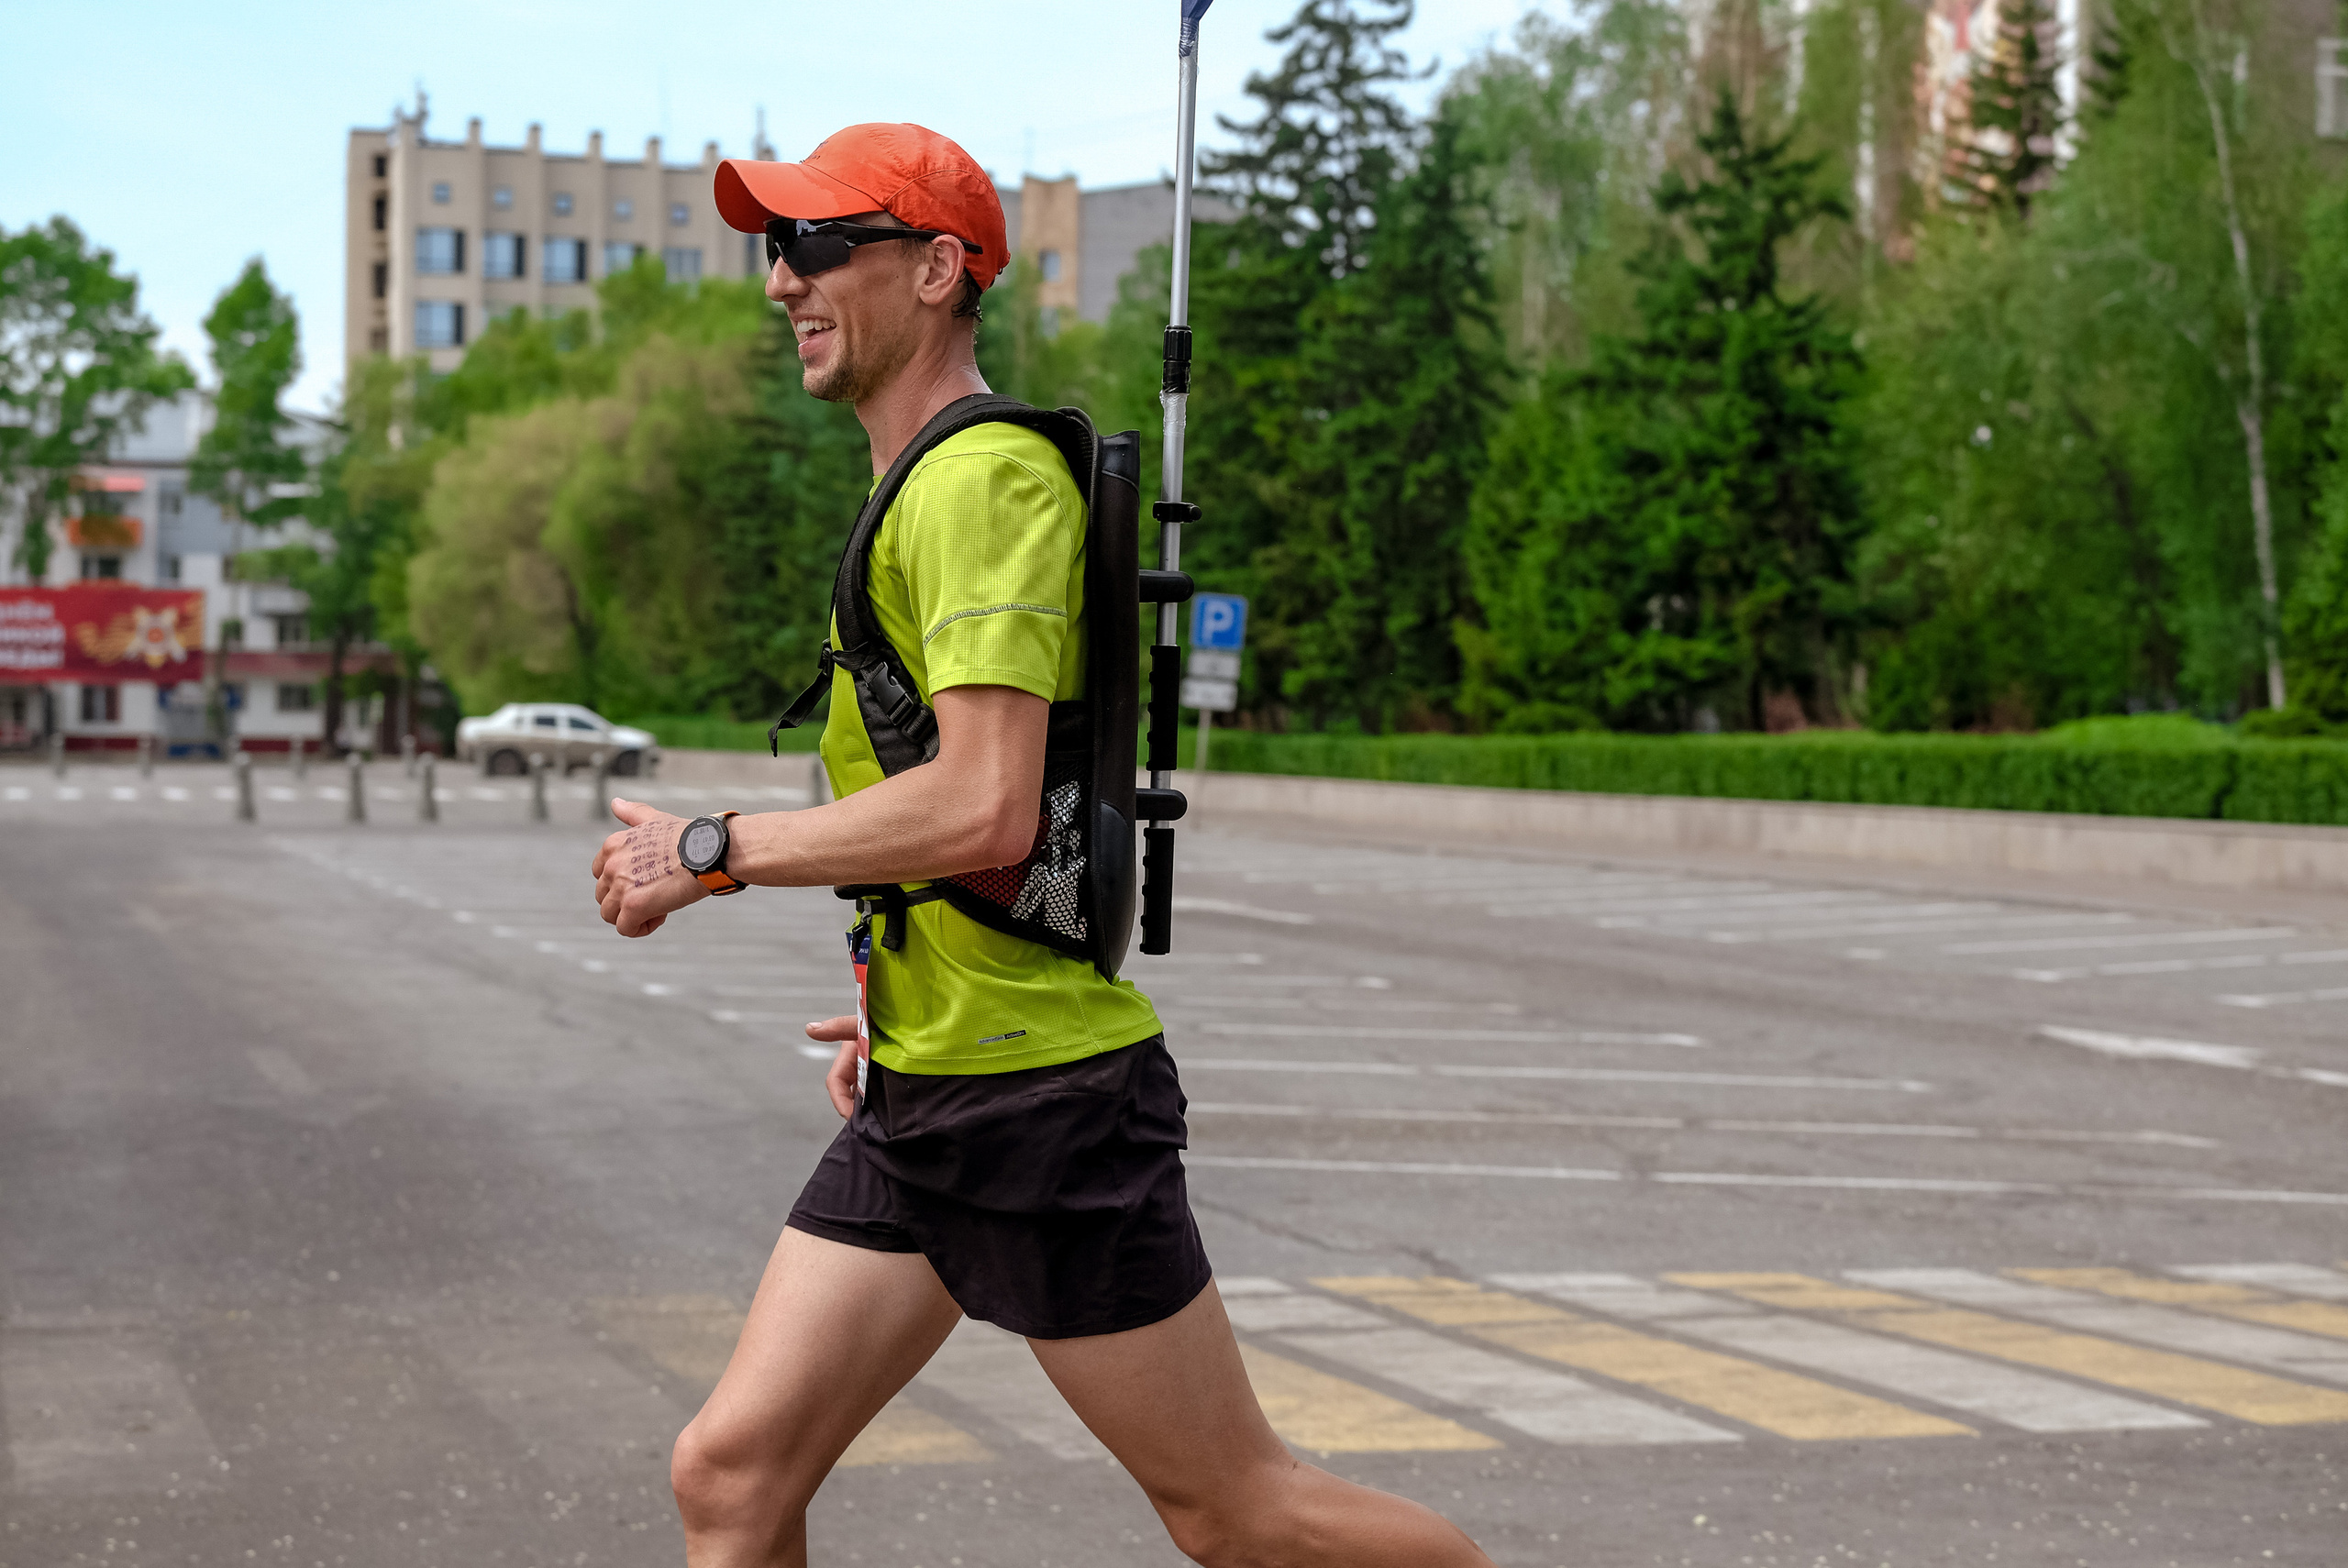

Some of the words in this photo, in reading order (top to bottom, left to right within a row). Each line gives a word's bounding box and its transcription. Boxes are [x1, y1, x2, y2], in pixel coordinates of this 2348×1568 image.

[1202, 601, 1234, 644] P
[632, 860, 656, 875] 28:00
[662, 856, 670, 865] 6
